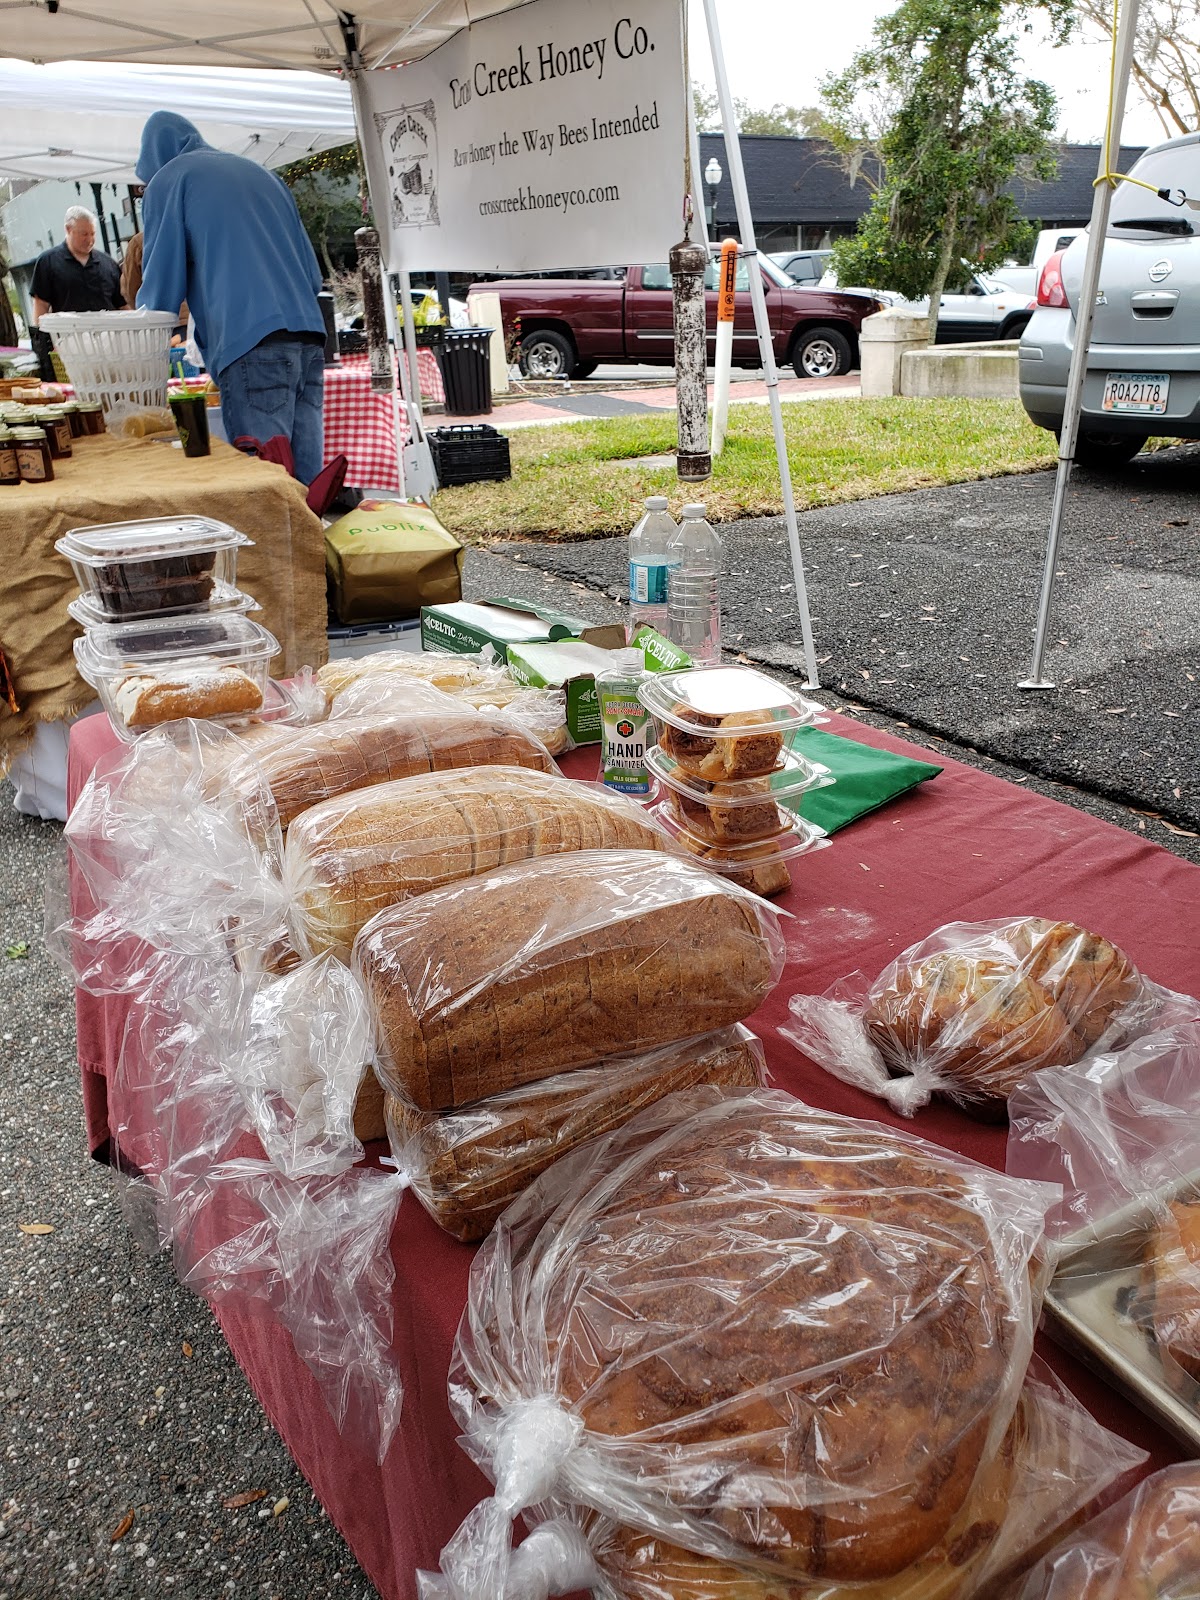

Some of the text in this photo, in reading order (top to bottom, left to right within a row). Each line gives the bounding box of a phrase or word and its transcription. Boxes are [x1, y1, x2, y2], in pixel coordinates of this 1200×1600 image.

[474, 45, 533, 97] Creek
[537, 38, 607, 80] Honey
[614, 18, 655, 59] Co.
[499, 131, 519, 157] the
[522, 129, 554, 156] Way
[558, 124, 589, 147] Bees
[591, 100, 661, 141] Intended
[479, 185, 620, 217] crosscreekhoneyco.com
[726, 251, 735, 292] WARNING
[1110, 383, 1160, 402] RQA2178
[1131, 374, 1166, 382] GEORGIA
[430, 618, 456, 638] CELTIC
[647, 639, 682, 669] CELTIC
[607, 741, 645, 769] HAND SANITIZER
